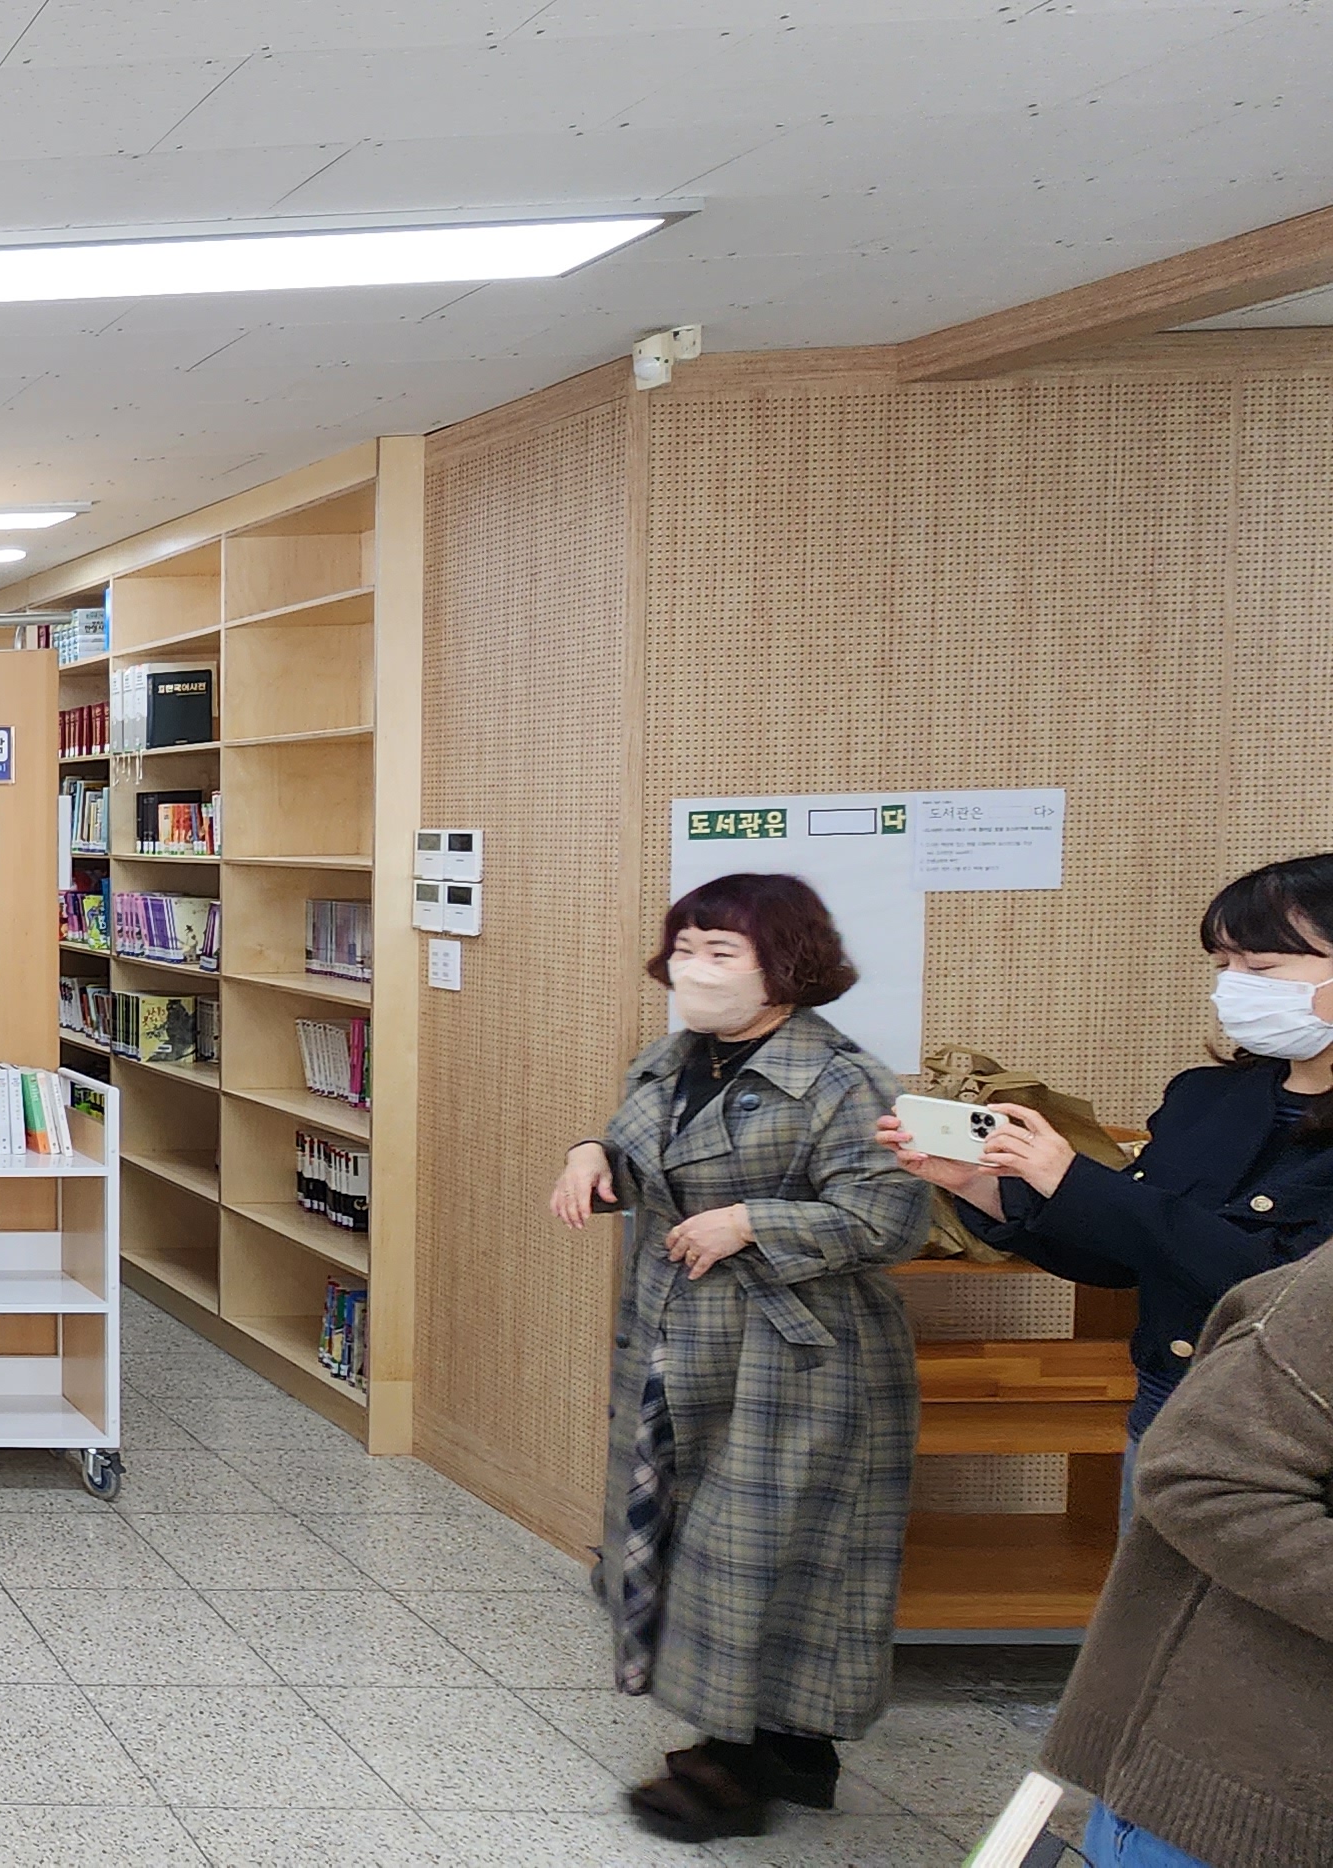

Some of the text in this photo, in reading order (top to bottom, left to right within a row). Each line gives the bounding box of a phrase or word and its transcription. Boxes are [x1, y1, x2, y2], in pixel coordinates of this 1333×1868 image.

[689, 808, 906, 838] 도서관은 다
[928, 806, 984, 821] 도서관은
